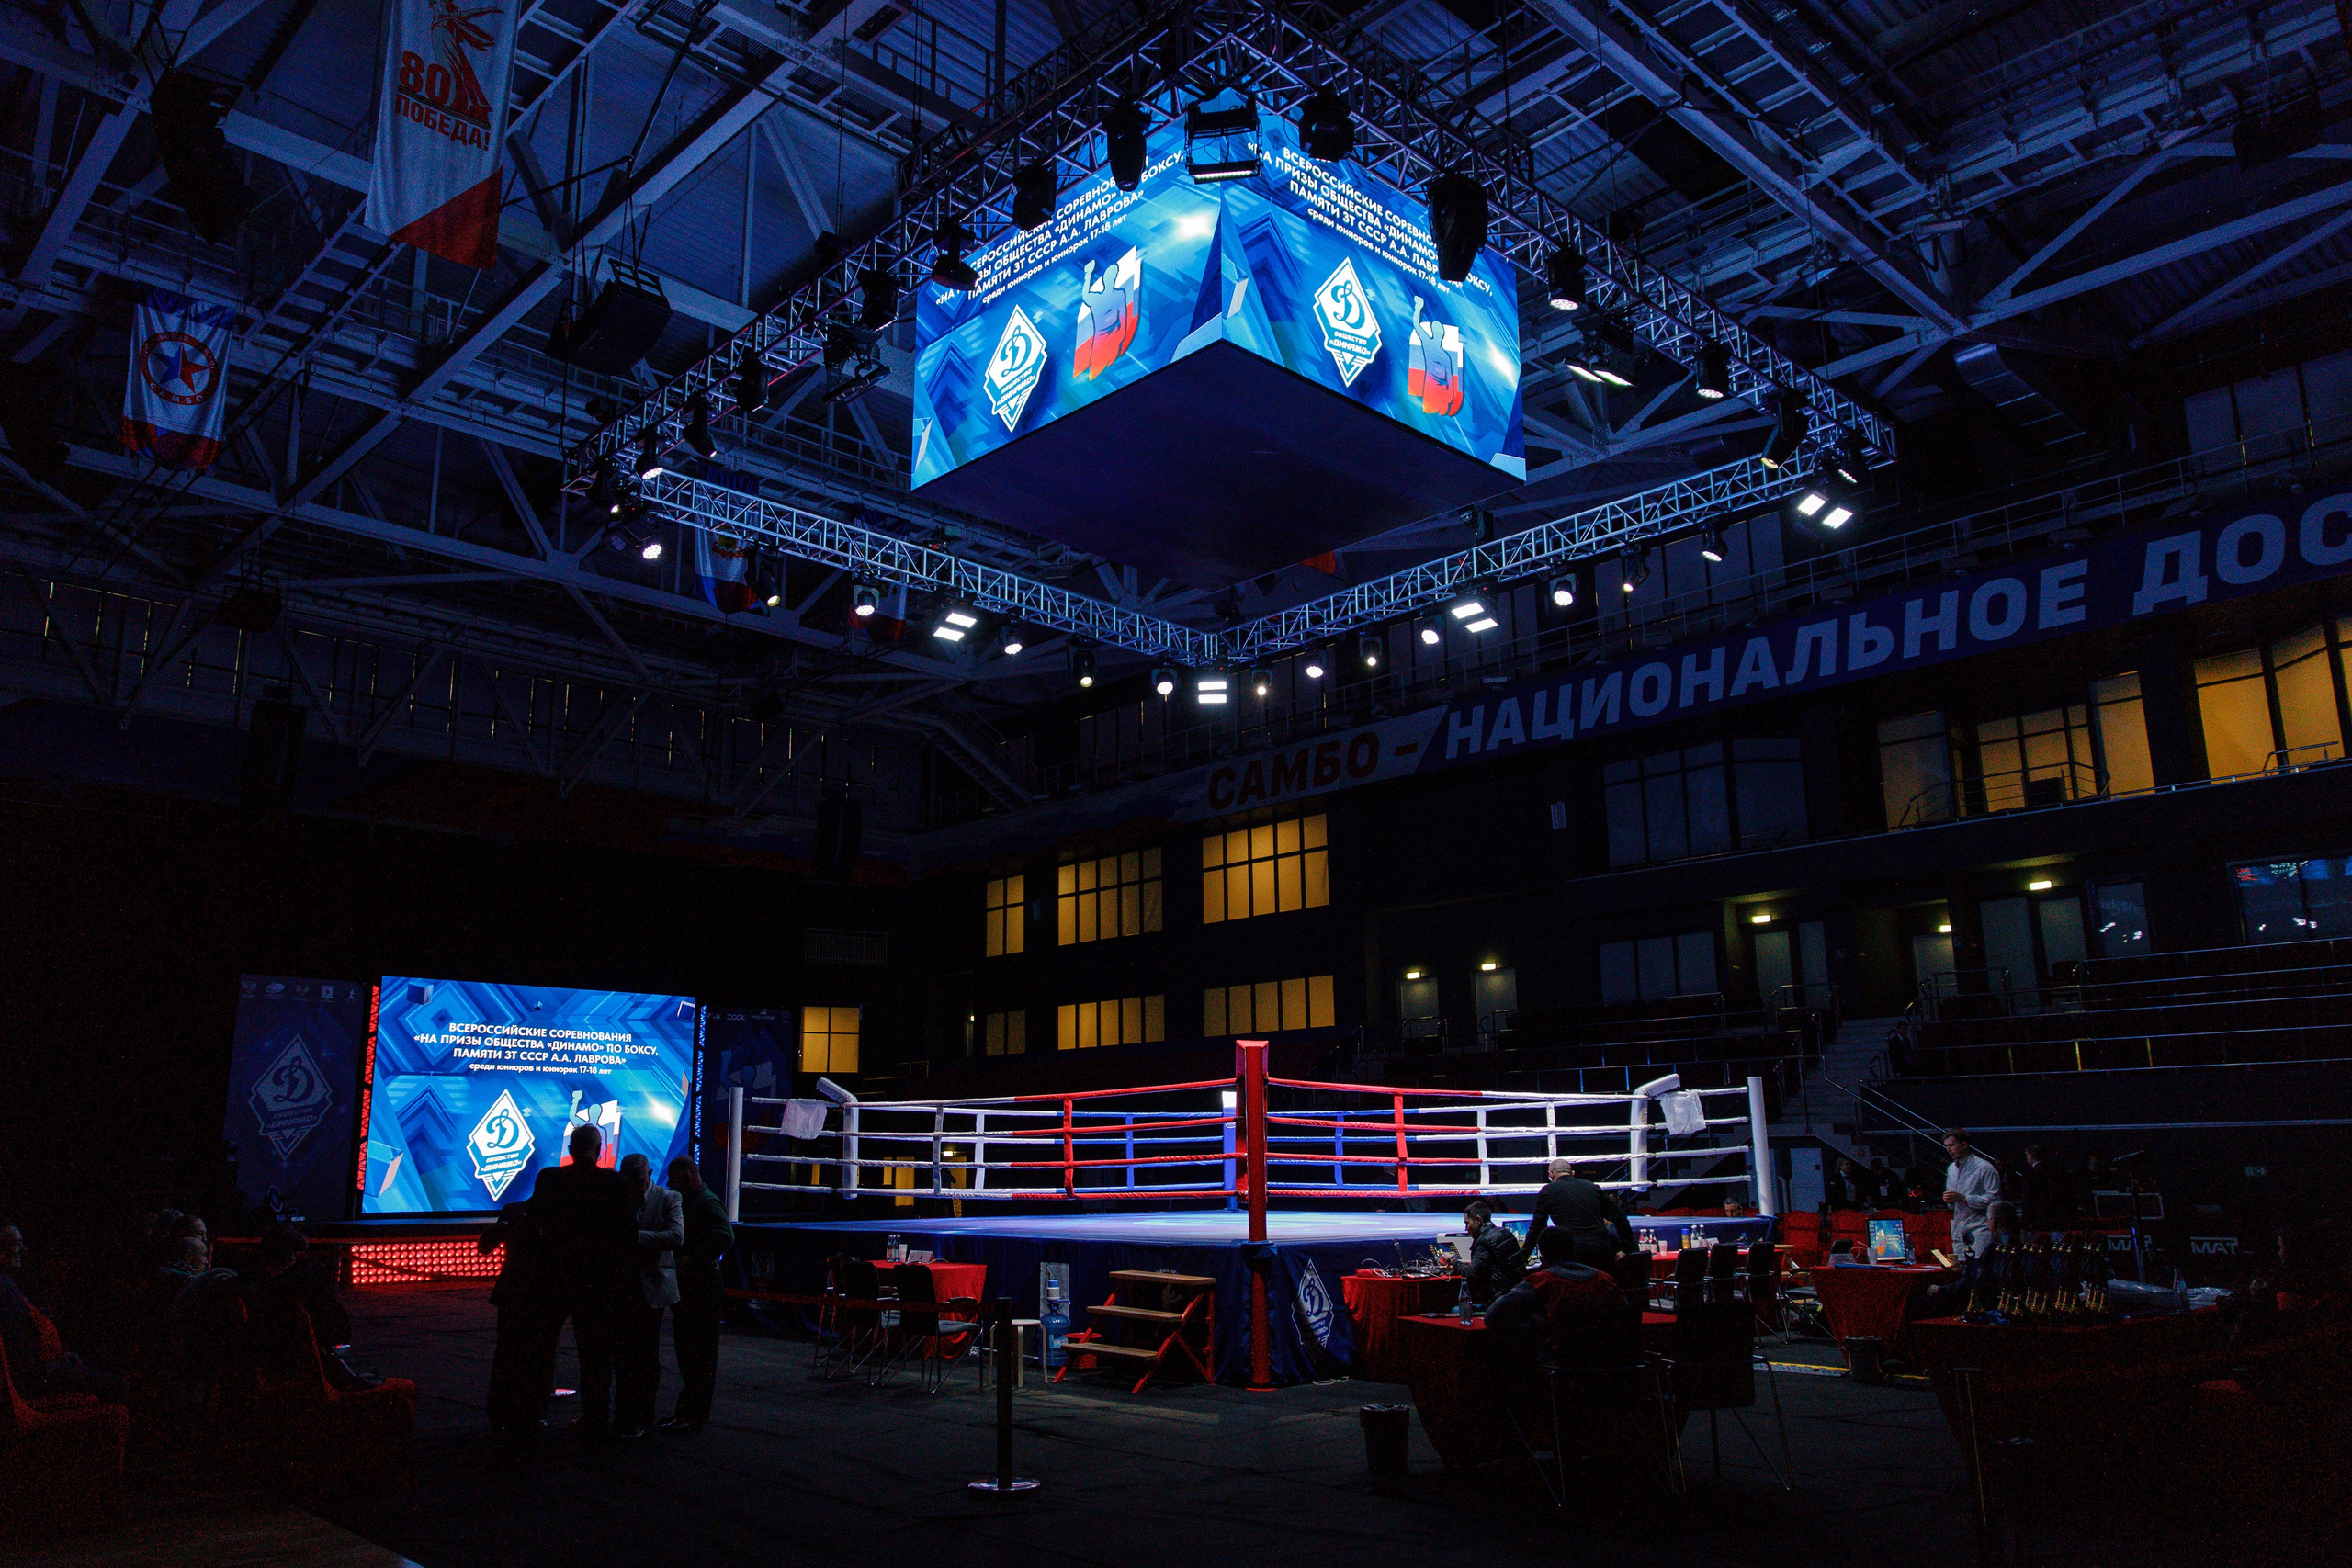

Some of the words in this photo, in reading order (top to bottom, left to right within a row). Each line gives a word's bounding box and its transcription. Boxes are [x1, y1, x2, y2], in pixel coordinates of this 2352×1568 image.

[400, 51, 451, 105] 80
[395, 94, 490, 152] ПОБЕДА!
[1283, 146, 1384, 217] ВСЕРОССИЙСКИЕ
[935, 288, 955, 306] «НА
[994, 230, 1052, 271] ОБЩЕСТВА
[1054, 191, 1117, 234] «ДИНАМО»
[1141, 150, 1185, 184] БОКСУ,
[1013, 257, 1026, 277] ЗТ
[1027, 239, 1058, 264] СССР
[1059, 228, 1081, 246] А.А.
[1083, 189, 1145, 232] ЛАВРОВА»
[1275, 156, 1317, 190] ПРИЗЫ
[1320, 185, 1382, 230] ОБЩЕСТВА
[1466, 272, 1493, 297] ОКСУ,
[1290, 179, 1340, 219] ПАМЯТИ
[1342, 210, 1355, 227] ЗТ
[1357, 220, 1387, 245] СССР
[1390, 239, 1410, 259] А.А.
[982, 285, 1005, 304] среди
[1007, 262, 1043, 288] юниоров
[1052, 236, 1089, 264] юниорок
[1090, 220, 1111, 241] 17-18
[1112, 213, 1127, 229] лет
[1307, 208, 1334, 229] среди
[1336, 223, 1374, 252] юниоров
[1382, 247, 1418, 276] юниорок
[1418, 268, 1436, 287] 17-18
[1437, 282, 1451, 294] лет
[1329, 338, 1371, 356] «ДИНАМО»
[1334, 330, 1367, 345] ОБЩЕСТВО
[997, 375, 1036, 406] «ДИНАМО»
[1001, 367, 1033, 394] ОБЩЕСТВО
[1207, 732, 1380, 811] САМБО
[1445, 558, 2088, 760] НАЦИОНАЛЬНОЕ
[2132, 493, 2352, 616] ДОС
[413, 1033, 437, 1044] «НА
[440, 1034, 481, 1046] ПРИЗЫ
[483, 1037, 544, 1050] ОБЩЕСТВА
[547, 1041, 605, 1052] «ДИНАМО»
[606, 1043, 622, 1054] ПО
[624, 1045, 659, 1057] БОКСУ,
[449, 1022, 547, 1038] ВСЕРОССИЙСКИЕ
[549, 1029, 632, 1043] СОРЕВНОВАНИЯ
[453, 1048, 502, 1059] ПАМЯТИ
[504, 1050, 518, 1061] ЗТ
[519, 1051, 549, 1062] СССР
[551, 1053, 572, 1063] А.А.
[573, 1055, 627, 1066] ЛАВРОВА»
[469, 1062, 493, 1072] среди
[496, 1064, 535, 1073] юниоров
[543, 1066, 578, 1074] юниорок
[579, 1066, 597, 1075] 17-18
[599, 1067, 612, 1076] лет
[481, 1159, 522, 1172] «ДИНАМО»
[485, 1153, 519, 1163] ОБЩЕСТВО
